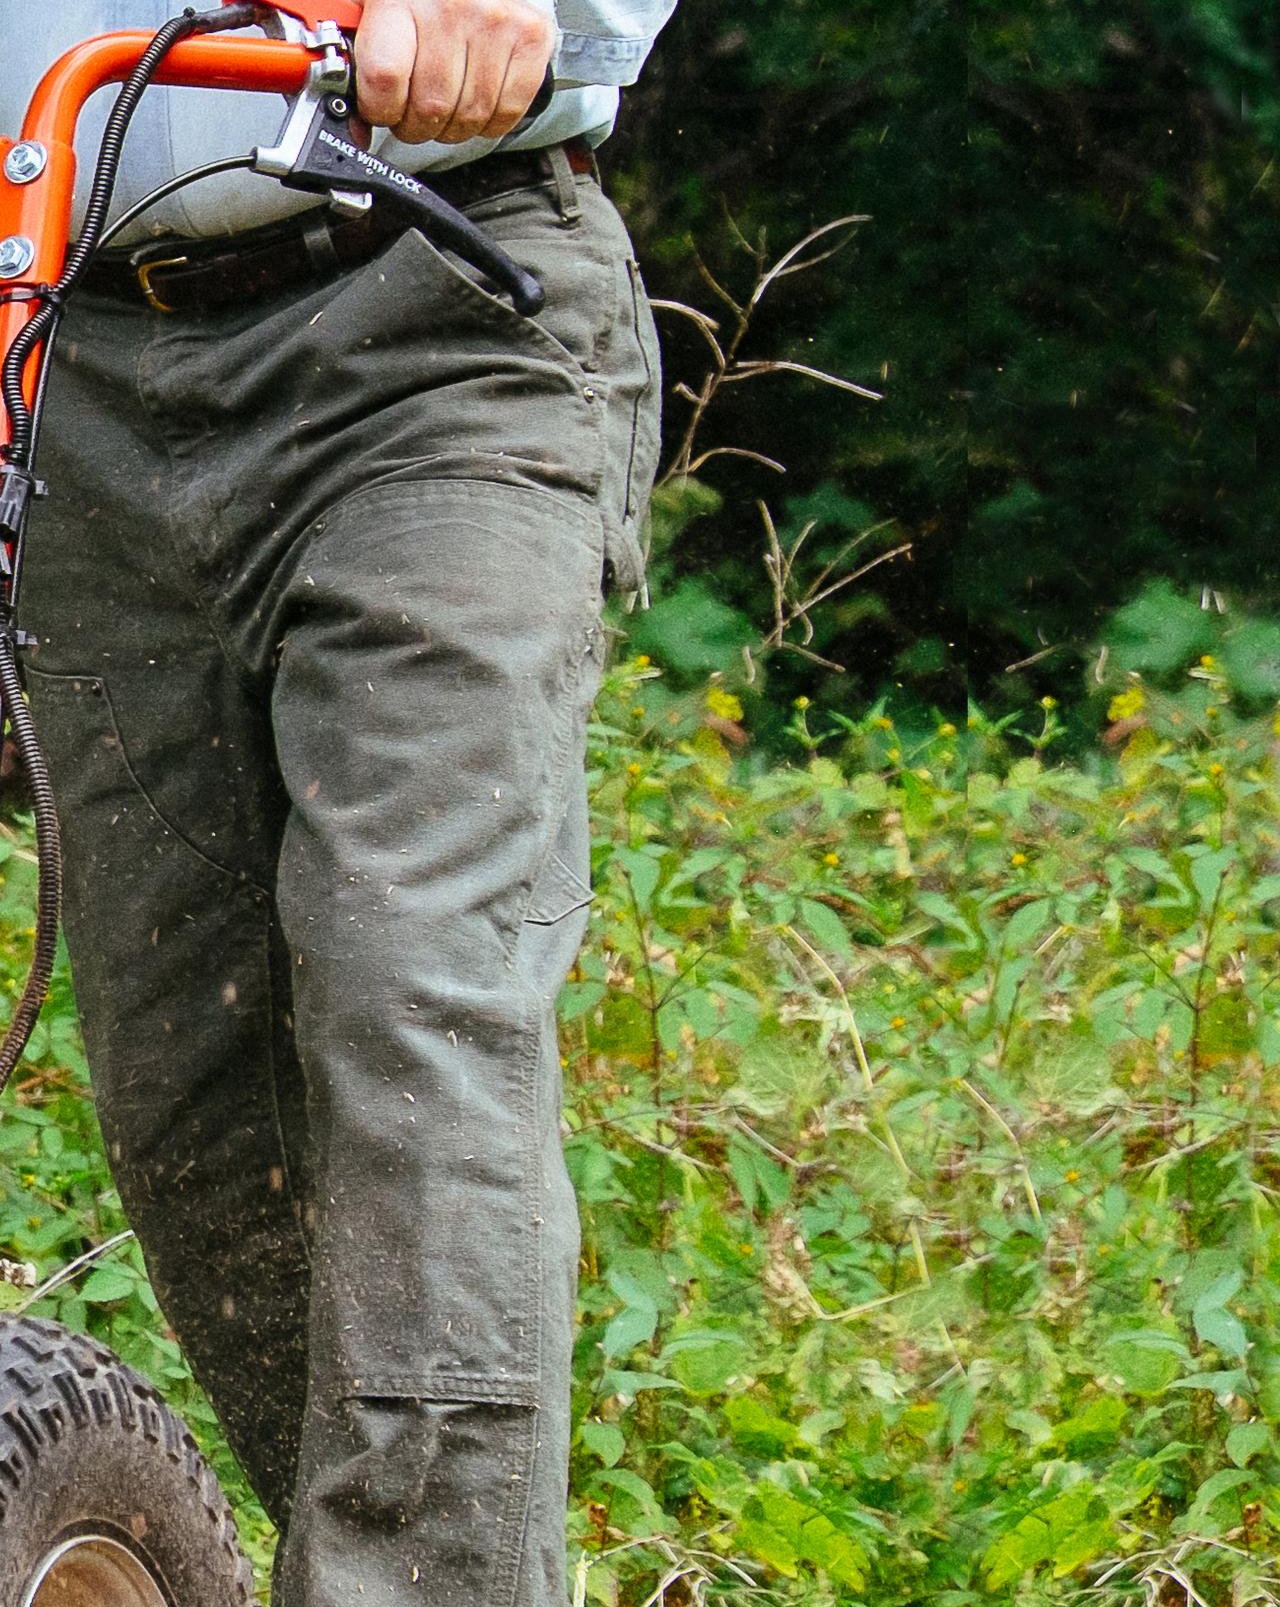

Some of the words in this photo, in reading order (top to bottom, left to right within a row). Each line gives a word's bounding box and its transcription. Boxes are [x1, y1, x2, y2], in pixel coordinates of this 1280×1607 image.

[318, 129, 356, 157] BRAKE
[357, 151, 389, 176] WITH
[389, 169, 423, 194] LOCK
